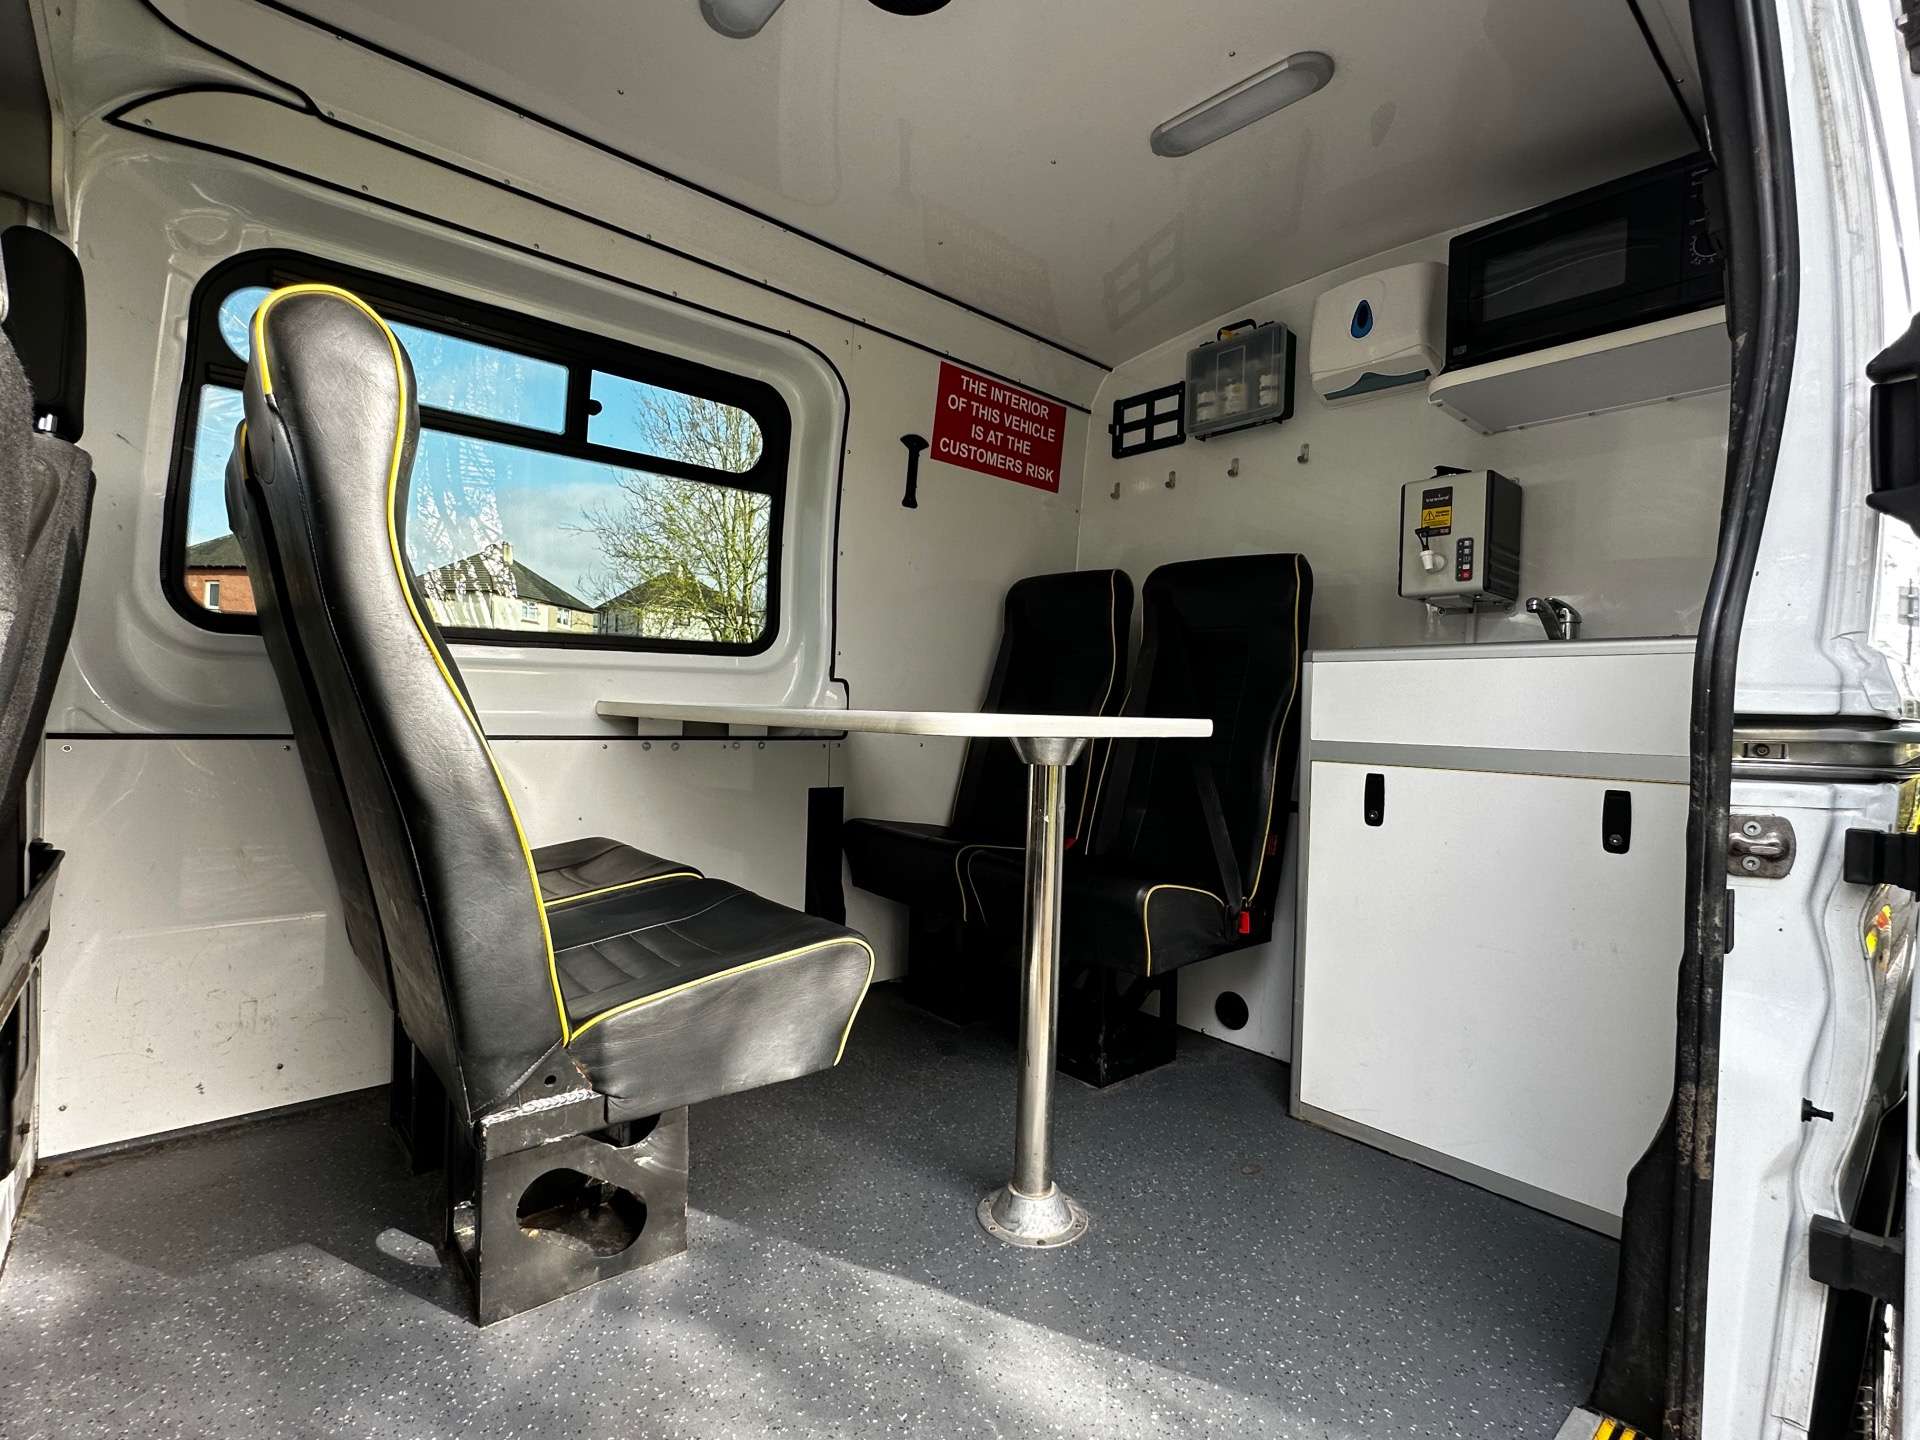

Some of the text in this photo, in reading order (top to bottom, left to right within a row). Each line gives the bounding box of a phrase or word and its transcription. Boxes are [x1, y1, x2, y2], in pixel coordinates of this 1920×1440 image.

[947, 394, 1056, 442] OF THIS VEHICLE
[961, 375, 1049, 419] THE INTERIOR
[939, 437, 1054, 483] CUSTOMERS RISK
[971, 423, 1031, 455] IS AT THE
